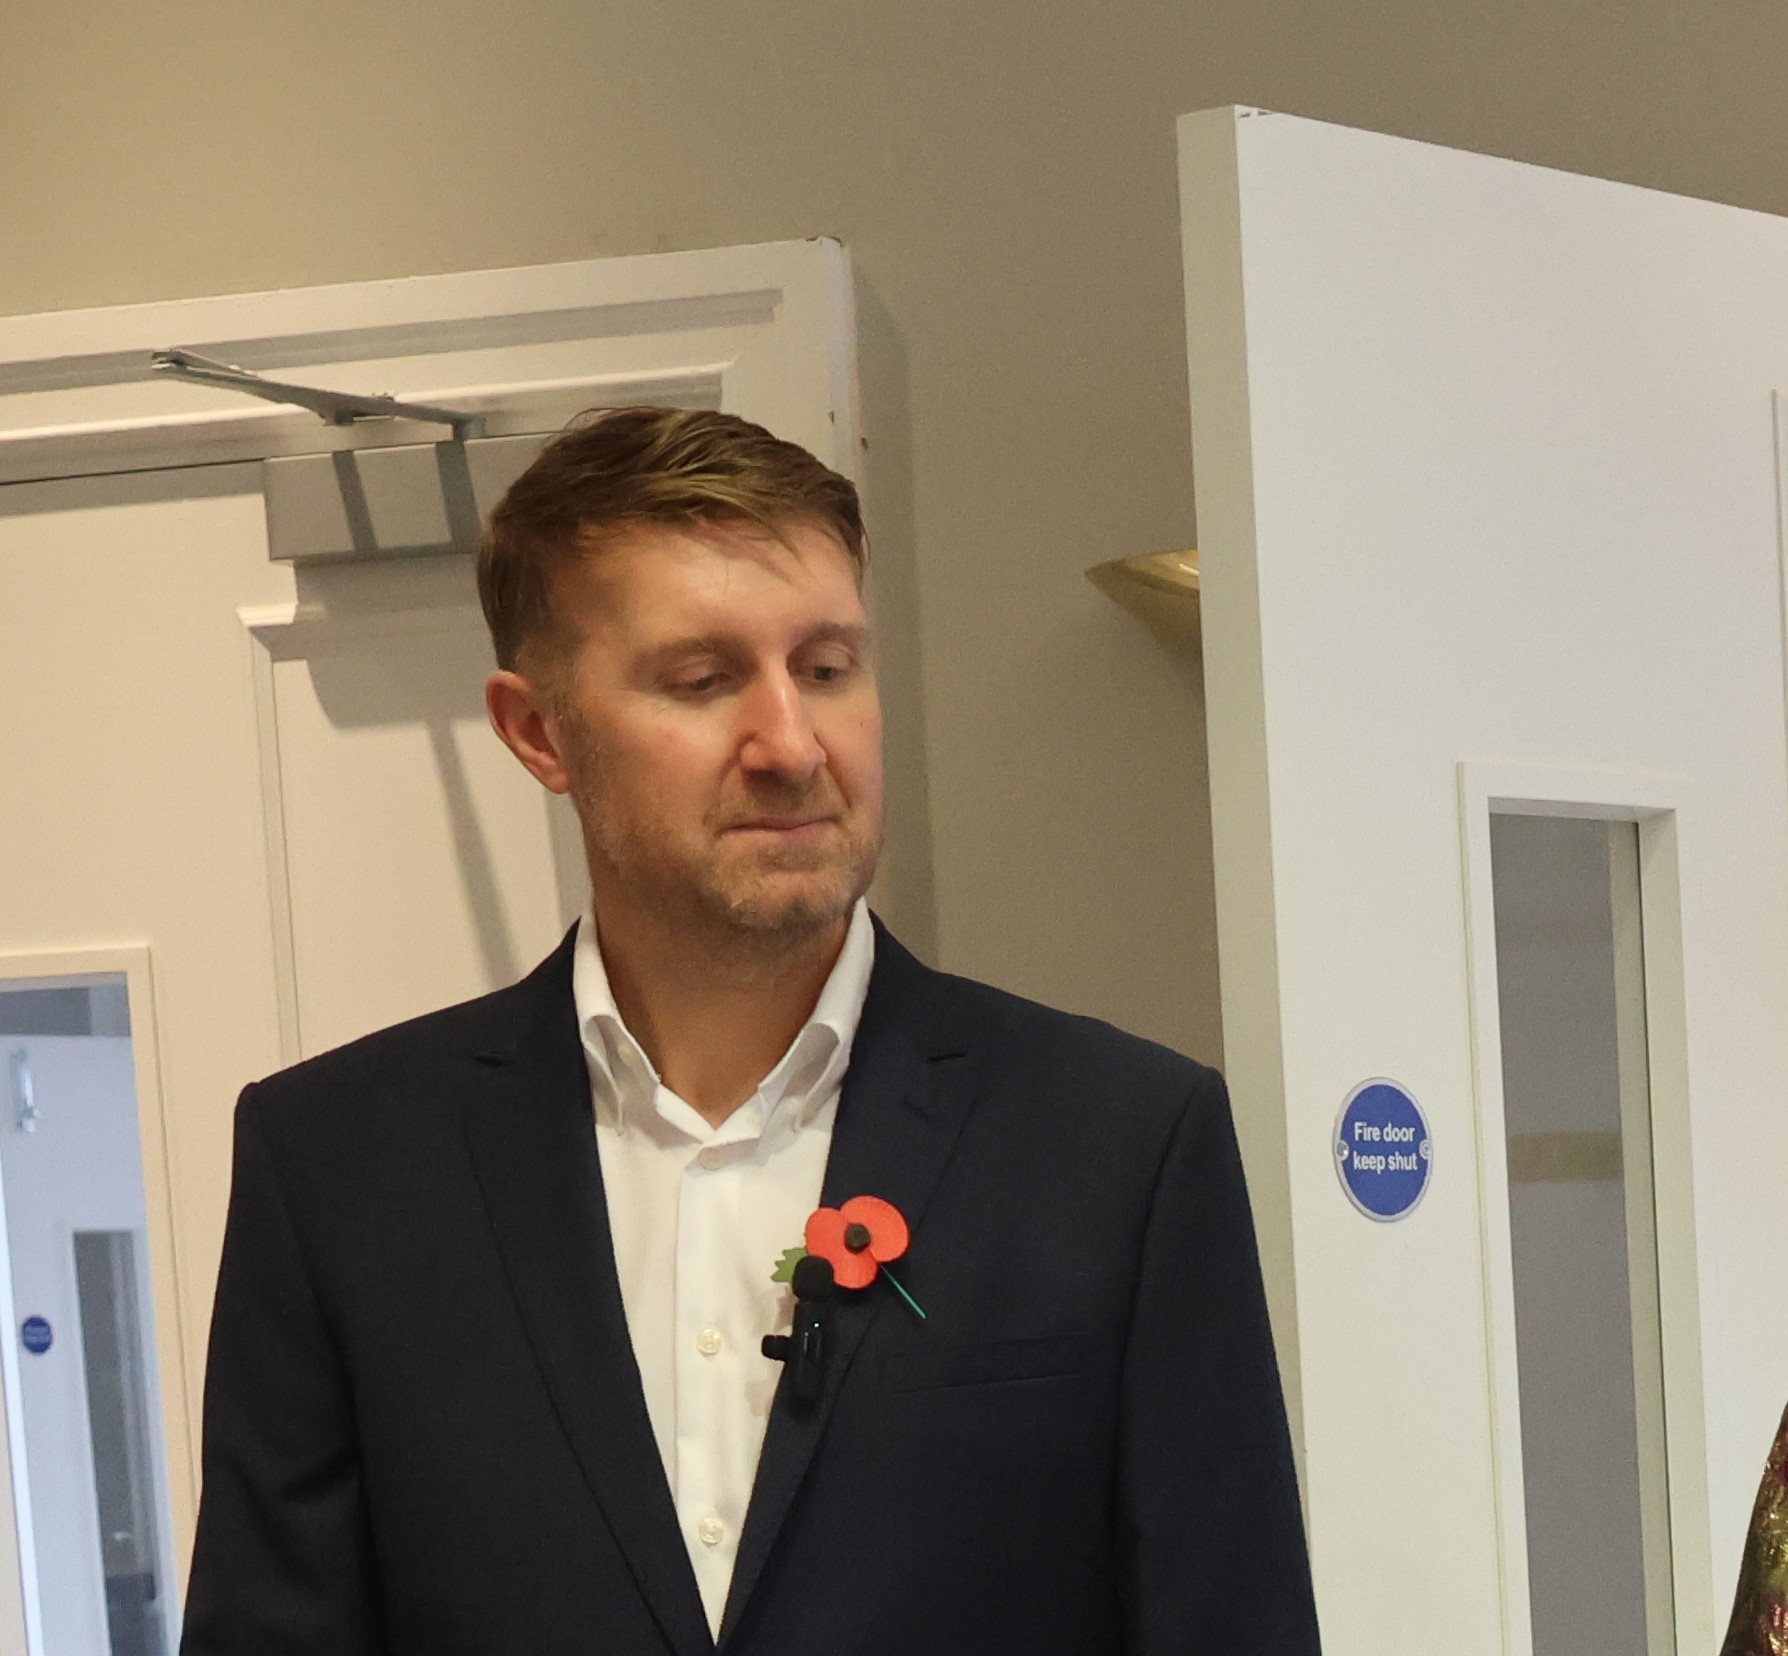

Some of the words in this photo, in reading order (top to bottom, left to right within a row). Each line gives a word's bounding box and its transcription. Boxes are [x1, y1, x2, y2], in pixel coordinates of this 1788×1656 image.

[1354, 1121, 1381, 1142] Fire
[1383, 1122, 1415, 1142] door
[1353, 1151, 1386, 1174] keep
[1388, 1152, 1418, 1171] shut
